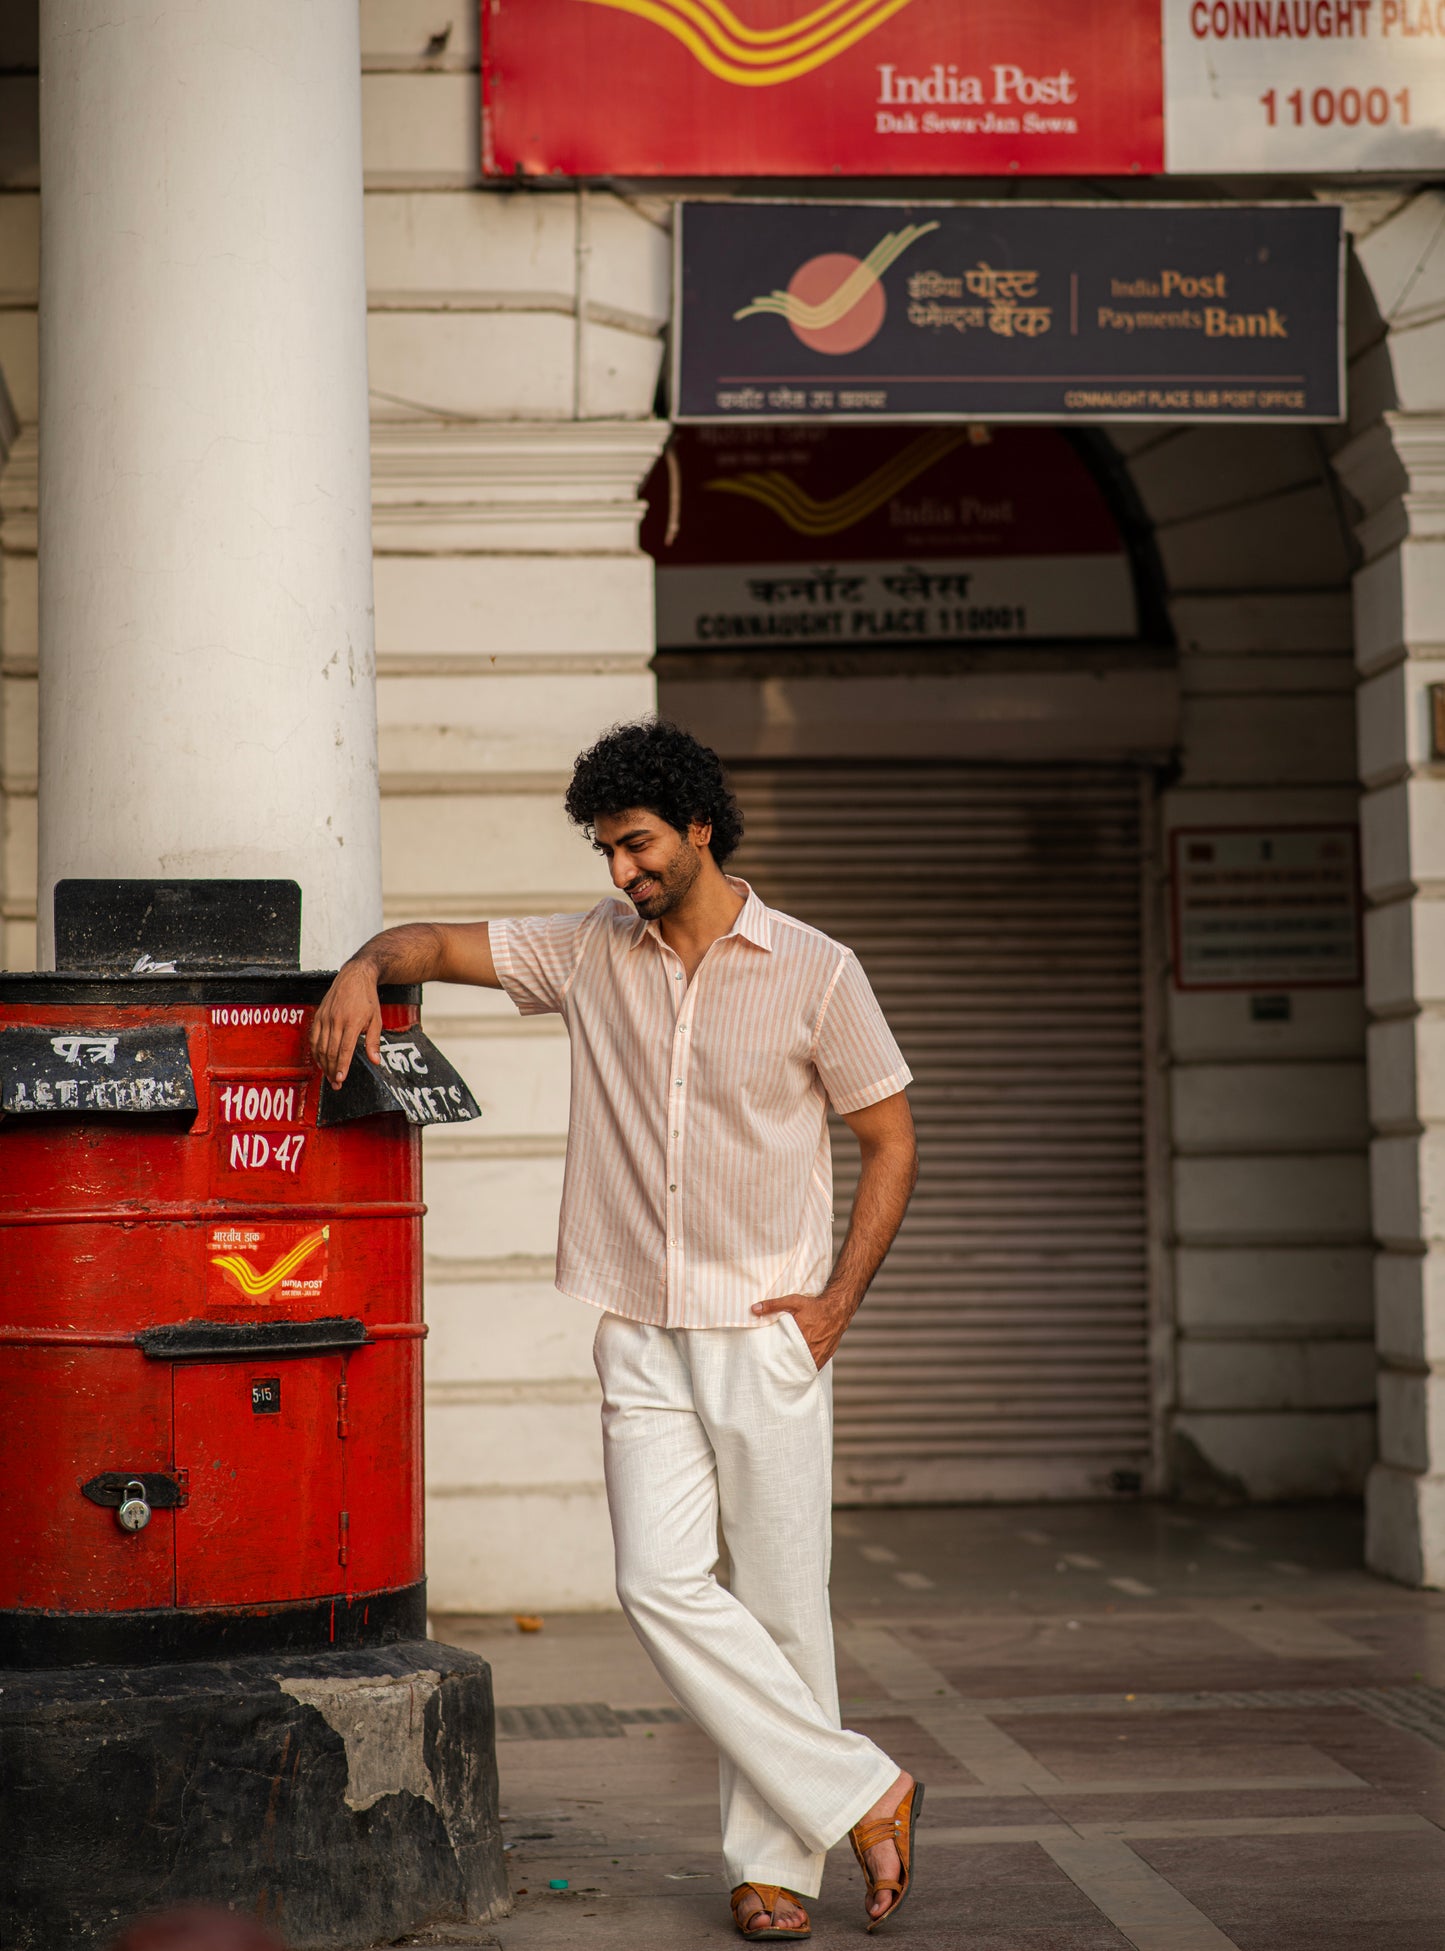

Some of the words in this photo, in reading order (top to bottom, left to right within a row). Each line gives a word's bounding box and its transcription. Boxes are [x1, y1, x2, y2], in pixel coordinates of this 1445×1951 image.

[1190, 0, 1371, 39] CONNAUGHT
[876, 64, 984, 104] India
[990, 64, 1078, 104] Post
[875, 111, 918, 133] Dak
[1022, 111, 1078, 133] Sewa
[1260, 87, 1410, 126] 110001
[964, 261, 1040, 298] पोस्ट
[1111, 279, 1160, 298] India
[1160, 270, 1227, 299] Post
[1098, 307, 1201, 333] Payments
[1203, 307, 1288, 338] Bank
[696, 611, 843, 639] CONNAUGHT
[851, 608, 927, 635] PLACE
[938, 606, 1027, 632] 110001
[211, 1008, 304, 1026] 110001000097
[50, 1036, 119, 1065] पत्र
[220, 1086, 294, 1121] 110001
[213, 1228, 241, 1242] भारतीय
[244, 1232, 260, 1242] डाक
[282, 1280, 303, 1288] INDIA
[304, 1280, 322, 1288] POST
